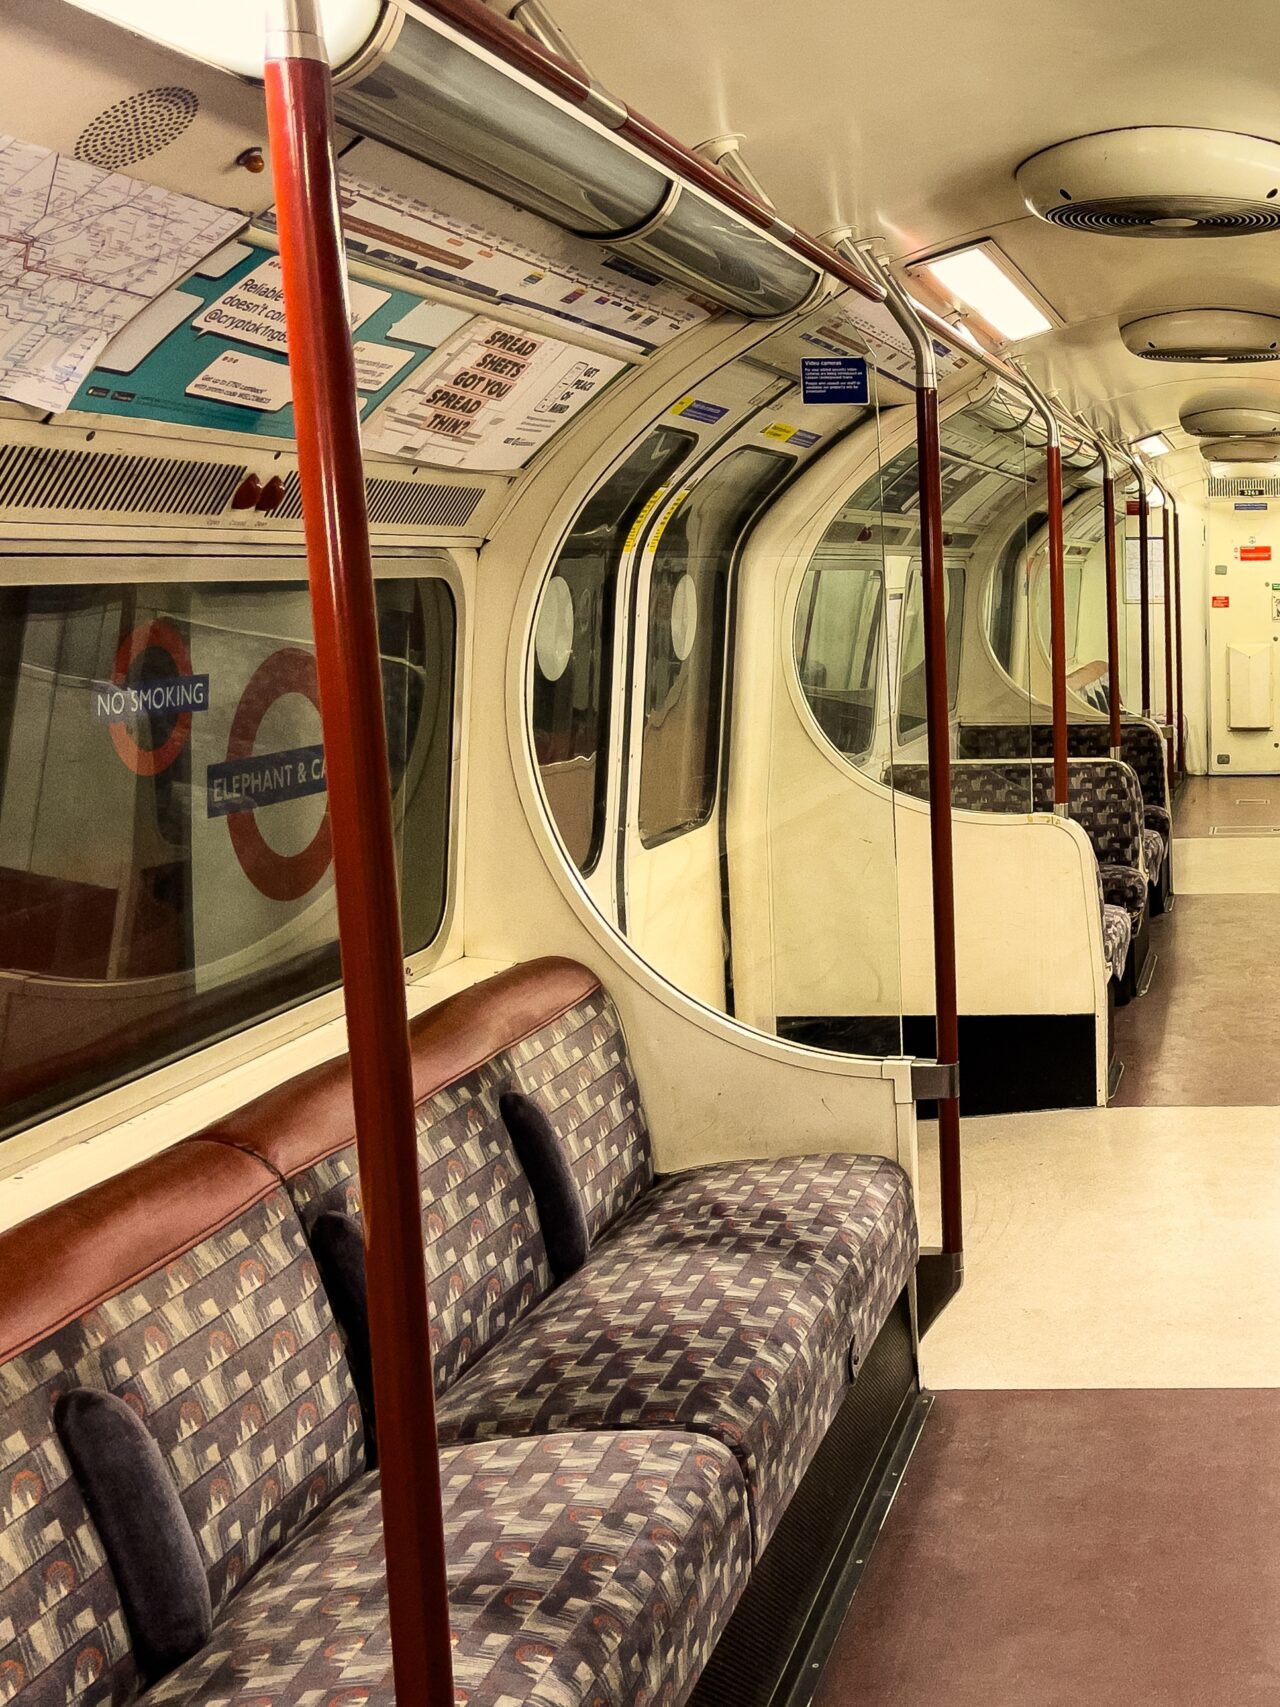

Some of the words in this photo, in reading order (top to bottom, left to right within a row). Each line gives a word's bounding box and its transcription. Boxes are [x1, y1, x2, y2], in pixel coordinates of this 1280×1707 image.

[222, 293, 266, 316] doesn't
[484, 330, 537, 357] SPREAD
[476, 353, 526, 378] SHEETS
[583, 367, 600, 378] GET
[453, 371, 484, 390] GOT
[482, 379, 513, 399] YOU
[426, 388, 482, 415] SPREAD
[427, 413, 471, 435] THIN?
[97, 691, 125, 717] NO
[130, 683, 204, 712] SMOKING
[213, 764, 293, 803] ELEPHANT
[297, 761, 307, 784] &
